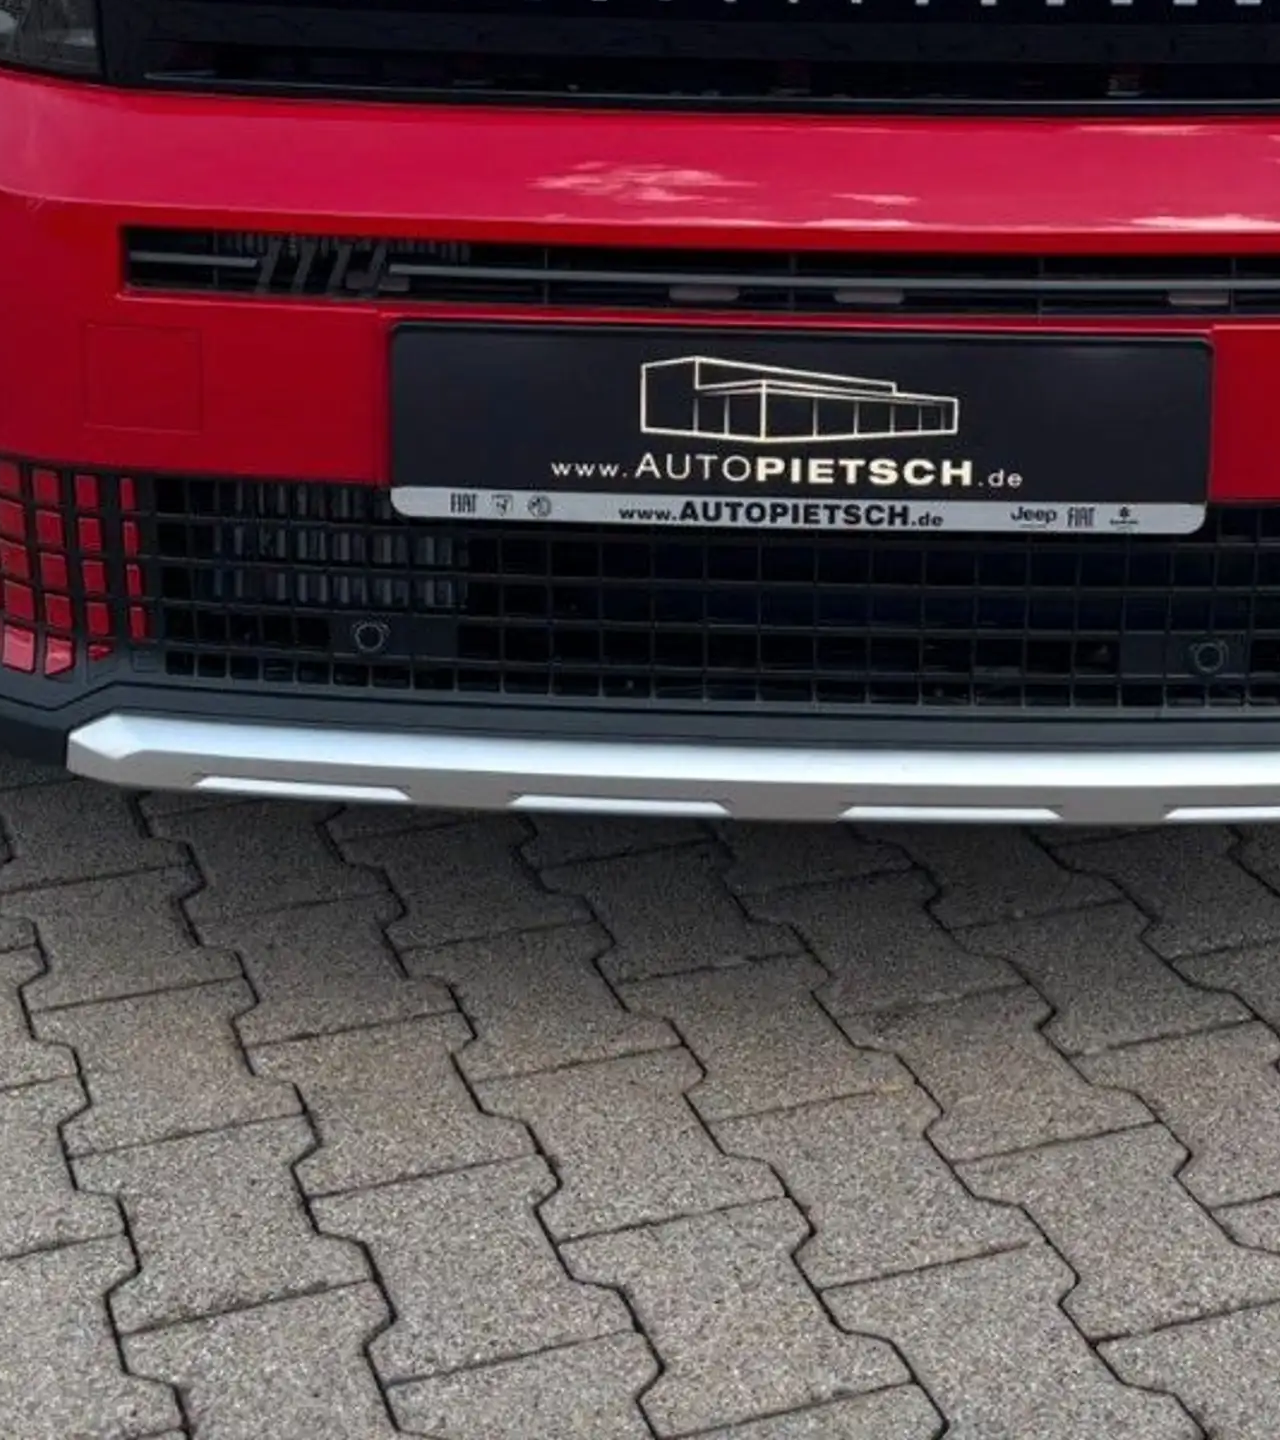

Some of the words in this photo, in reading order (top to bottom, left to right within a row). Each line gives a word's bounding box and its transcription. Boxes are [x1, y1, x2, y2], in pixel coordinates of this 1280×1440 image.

[551, 452, 1023, 489] www.AUTOPIETSCH.de
[450, 492, 477, 513] FIAT
[618, 500, 944, 528] www.AUTOPIETSCH.de
[1010, 505, 1057, 525] Jeep
[1066, 506, 1095, 528] FIAT
